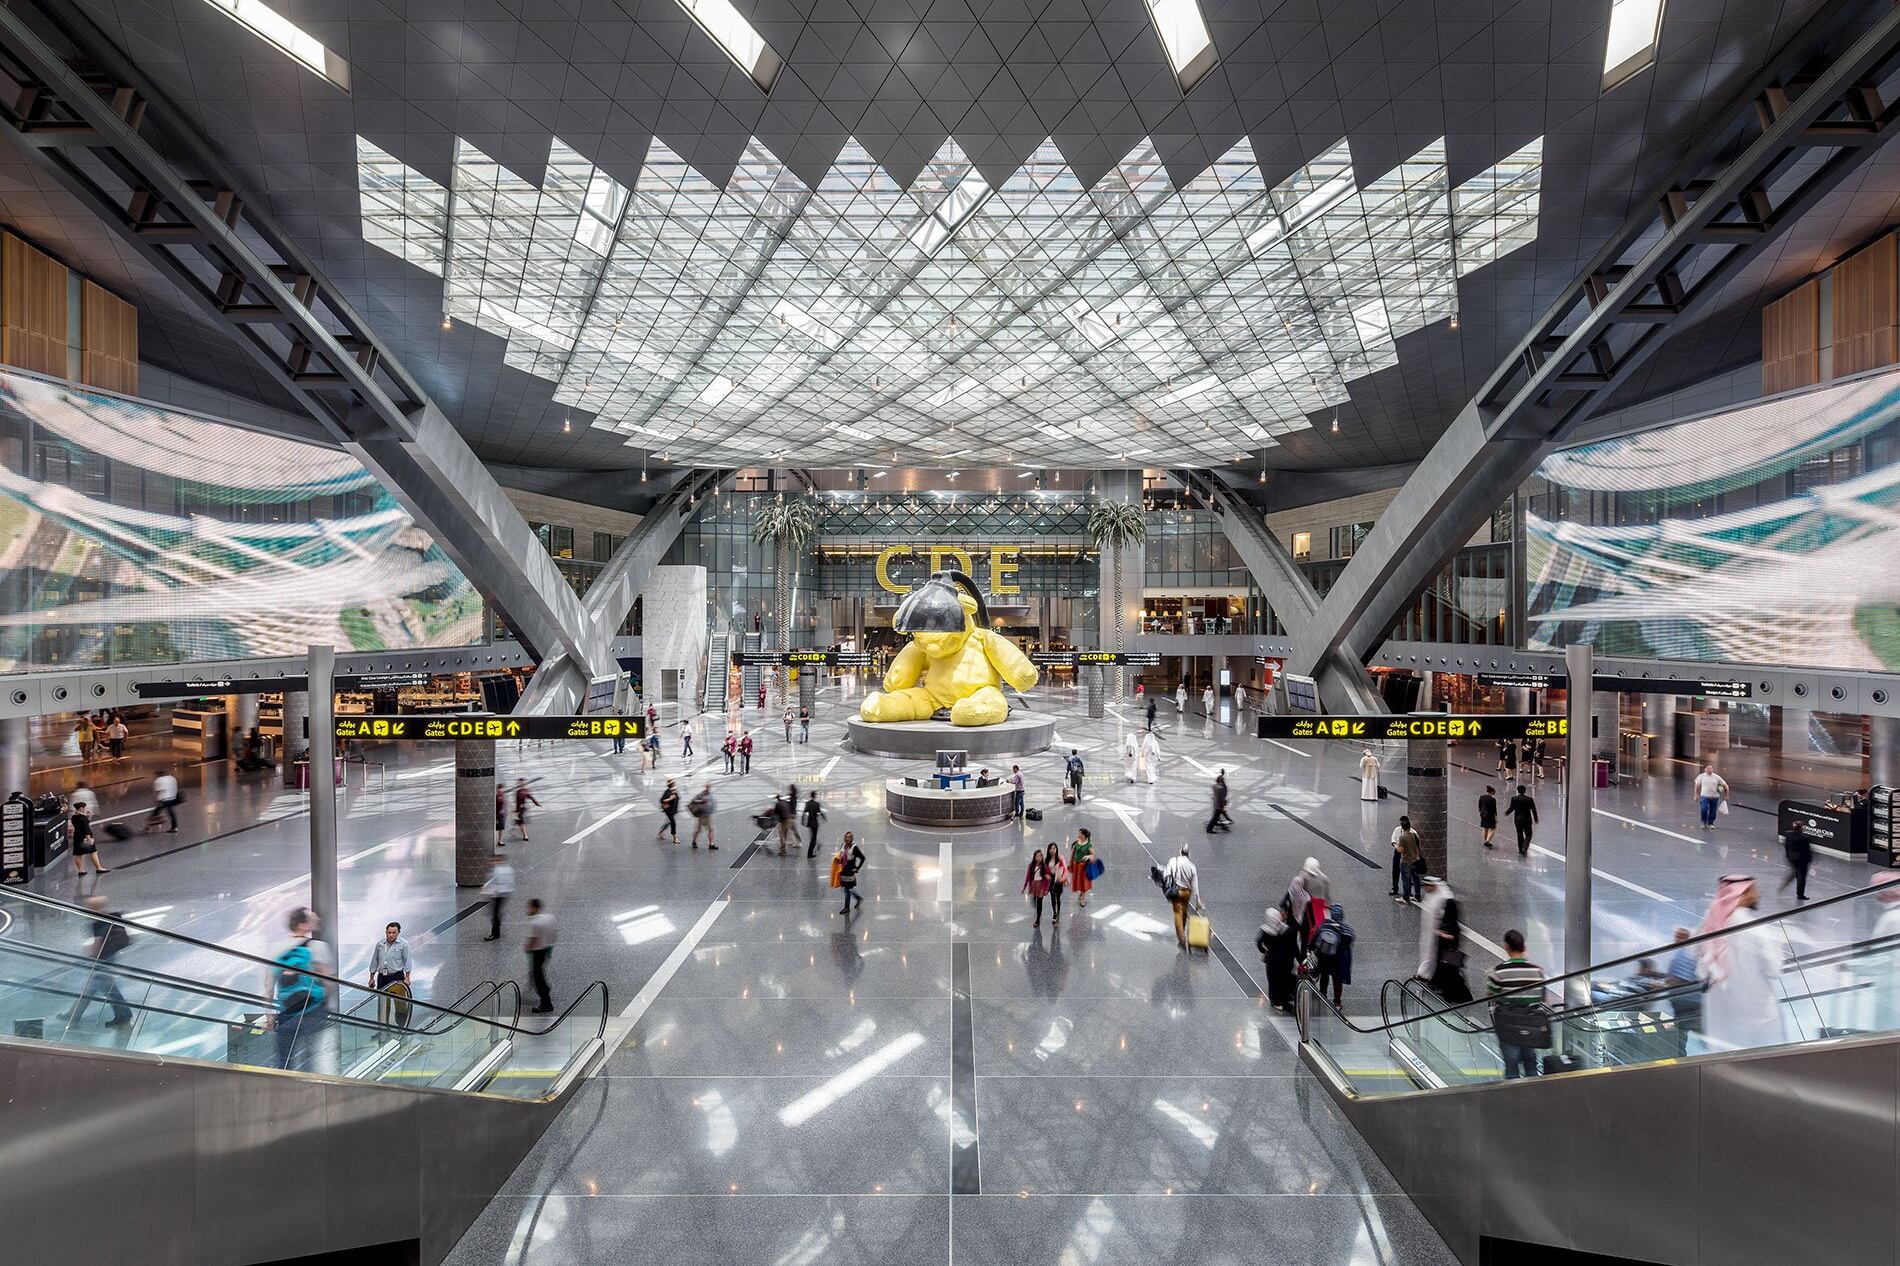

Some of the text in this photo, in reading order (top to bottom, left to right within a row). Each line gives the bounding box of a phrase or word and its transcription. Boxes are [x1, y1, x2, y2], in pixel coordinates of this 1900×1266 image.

[336, 721, 370, 737] Gates A
[426, 728, 445, 737] Gates
[568, 721, 601, 737] Gates B
[1294, 721, 1329, 737] Gates A
[1388, 728, 1408, 737] Gates
[1526, 721, 1557, 737] Gates B
